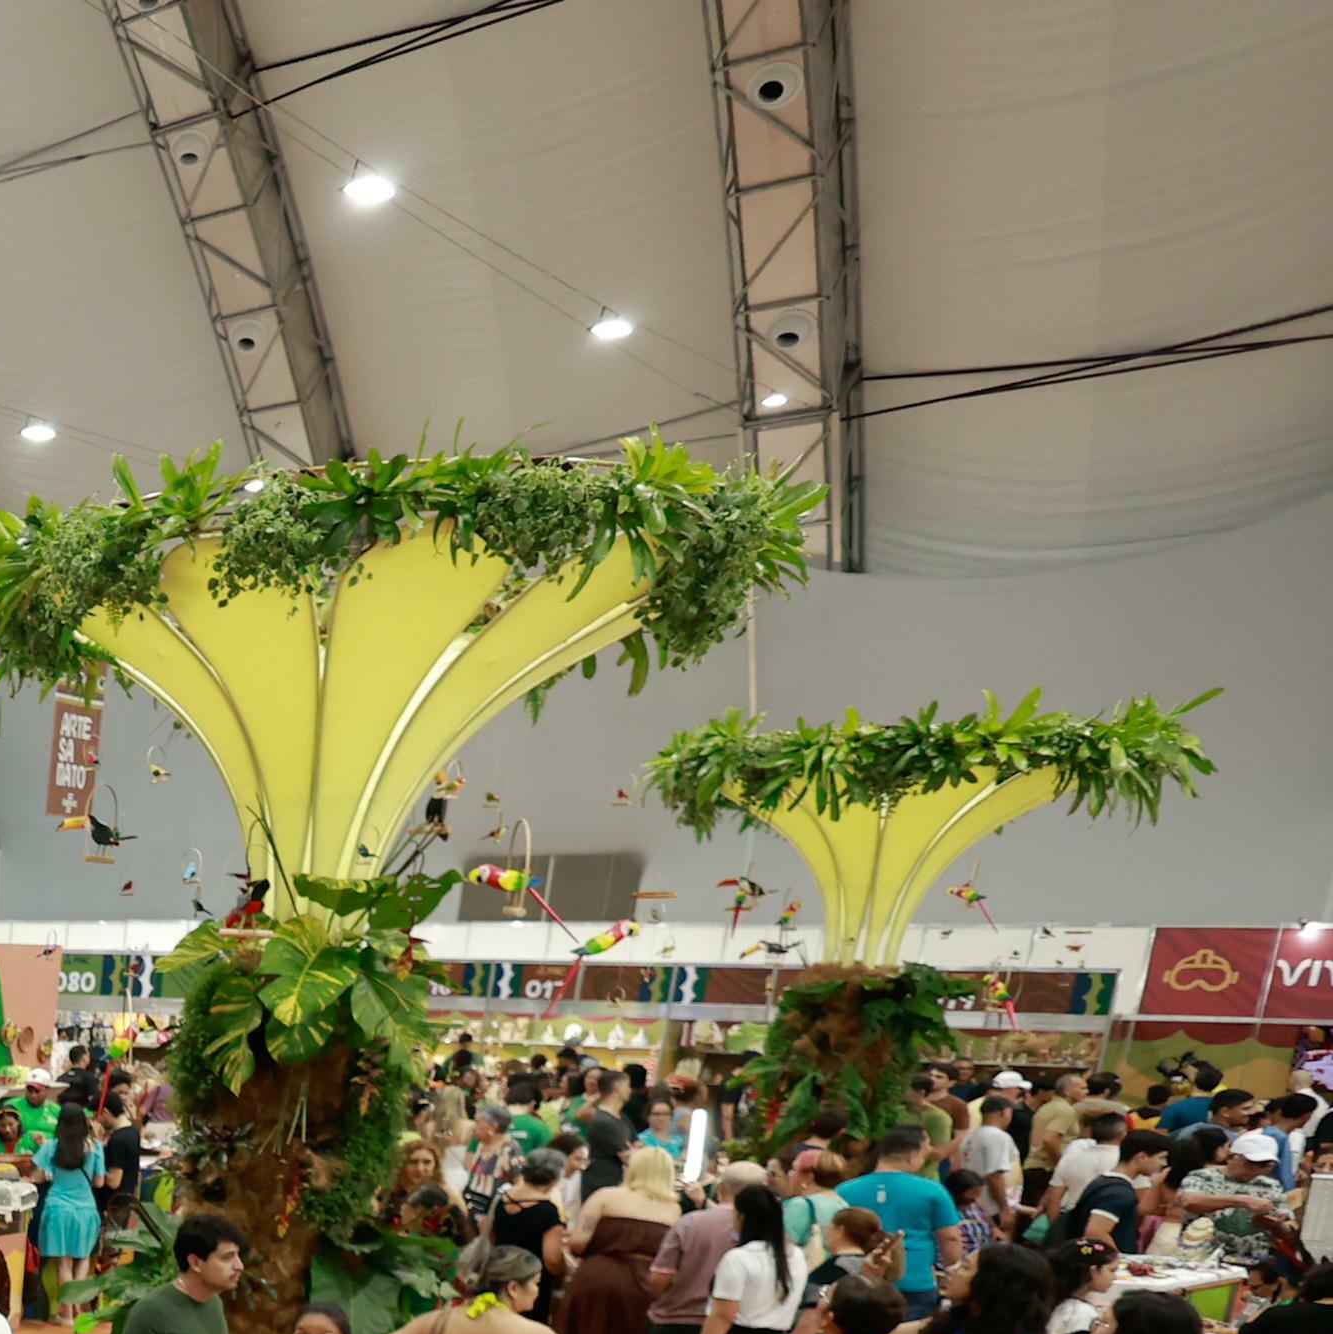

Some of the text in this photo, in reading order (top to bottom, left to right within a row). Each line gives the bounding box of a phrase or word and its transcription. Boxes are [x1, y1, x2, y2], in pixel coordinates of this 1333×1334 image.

[60, 711, 93, 740] ARTE
[58, 737, 75, 762] SA
[1276, 958, 1333, 987] VI
